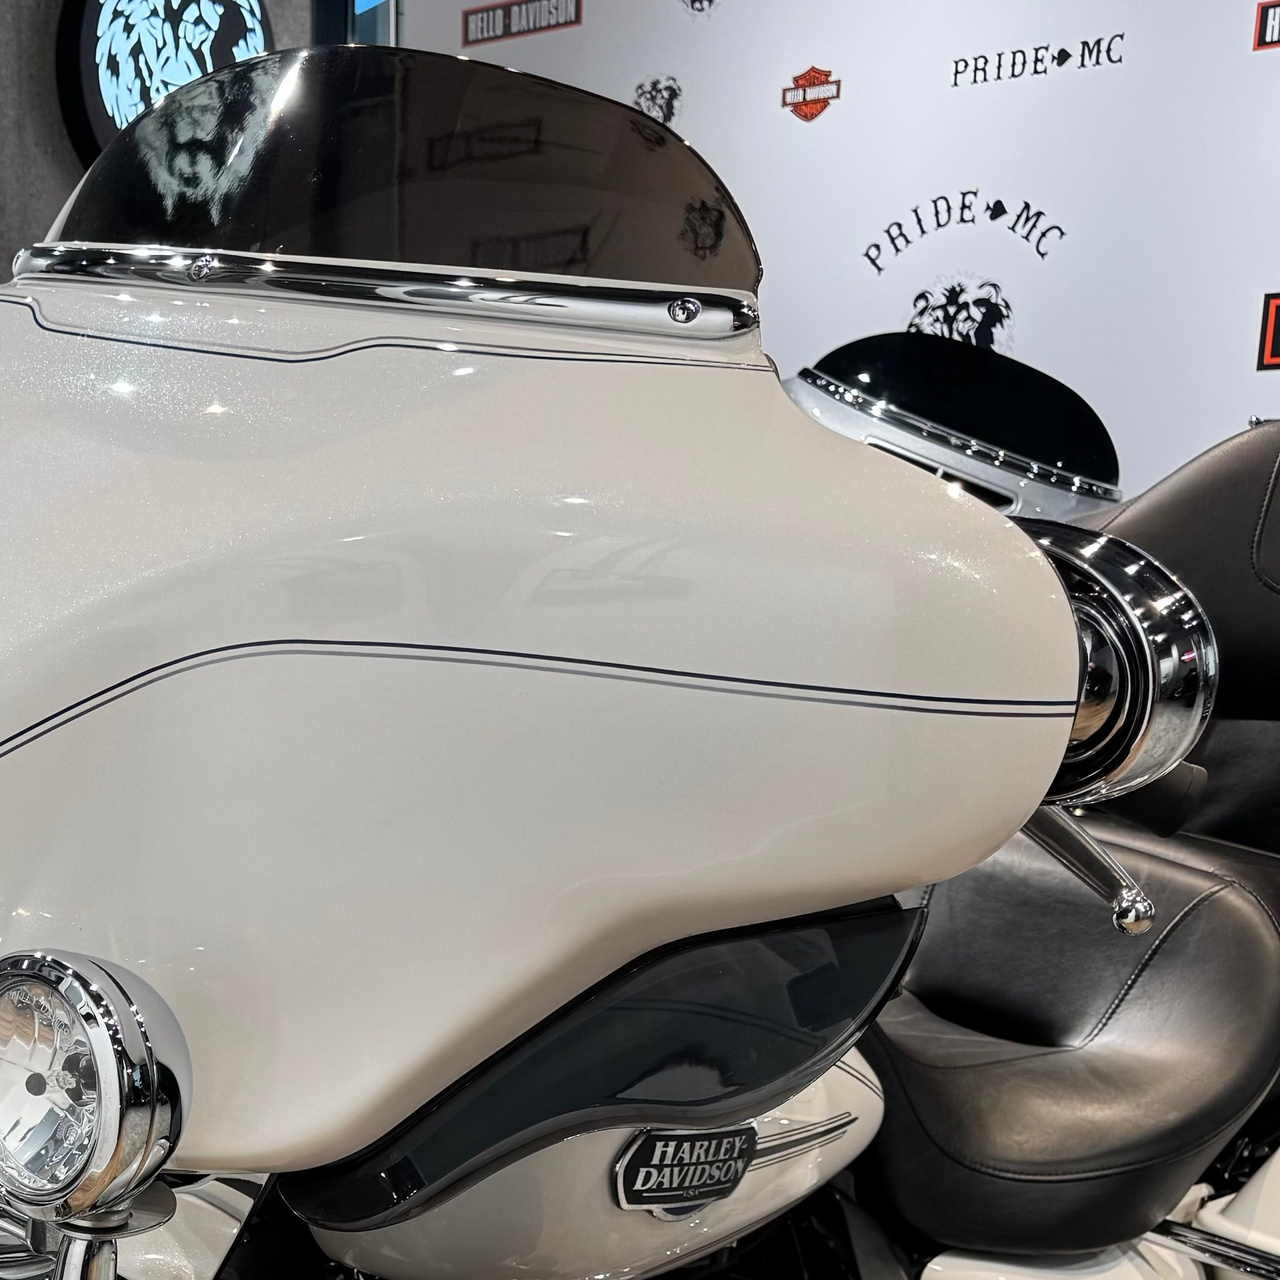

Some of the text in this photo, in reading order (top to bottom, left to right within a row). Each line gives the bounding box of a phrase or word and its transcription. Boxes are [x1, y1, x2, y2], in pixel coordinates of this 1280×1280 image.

[951, 32, 1125, 88] PRIDE MC
[862, 188, 1067, 275] PRIDE MC
[632, 1157, 748, 1191] DAVIDSON
